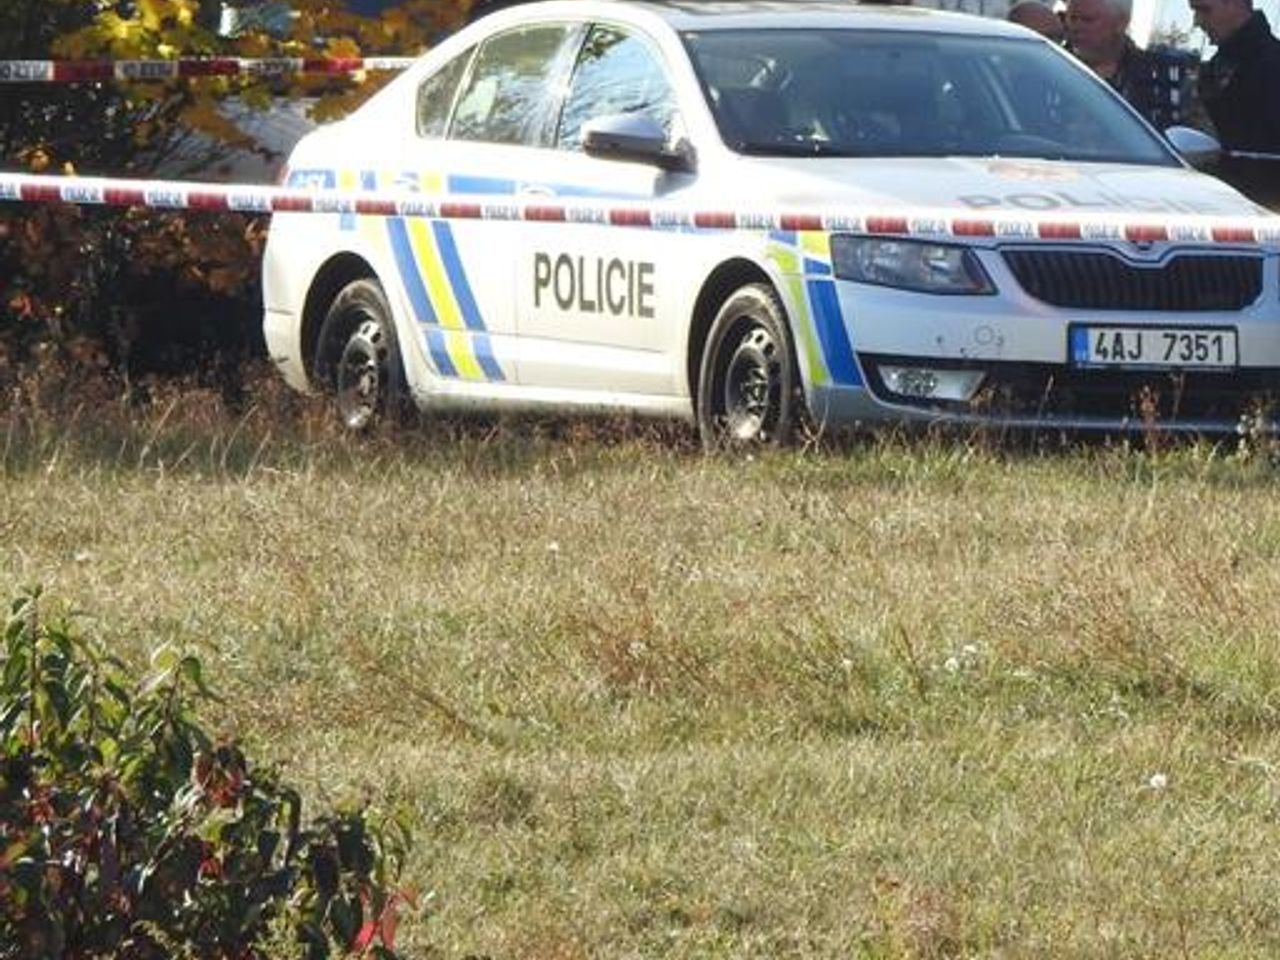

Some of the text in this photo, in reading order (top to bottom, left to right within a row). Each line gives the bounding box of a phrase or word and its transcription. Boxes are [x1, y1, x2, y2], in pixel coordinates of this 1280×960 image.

[956, 189, 1221, 215] POLICIE
[534, 251, 655, 319] POLICIE
[1095, 332, 1223, 362] 4AJ 7351
